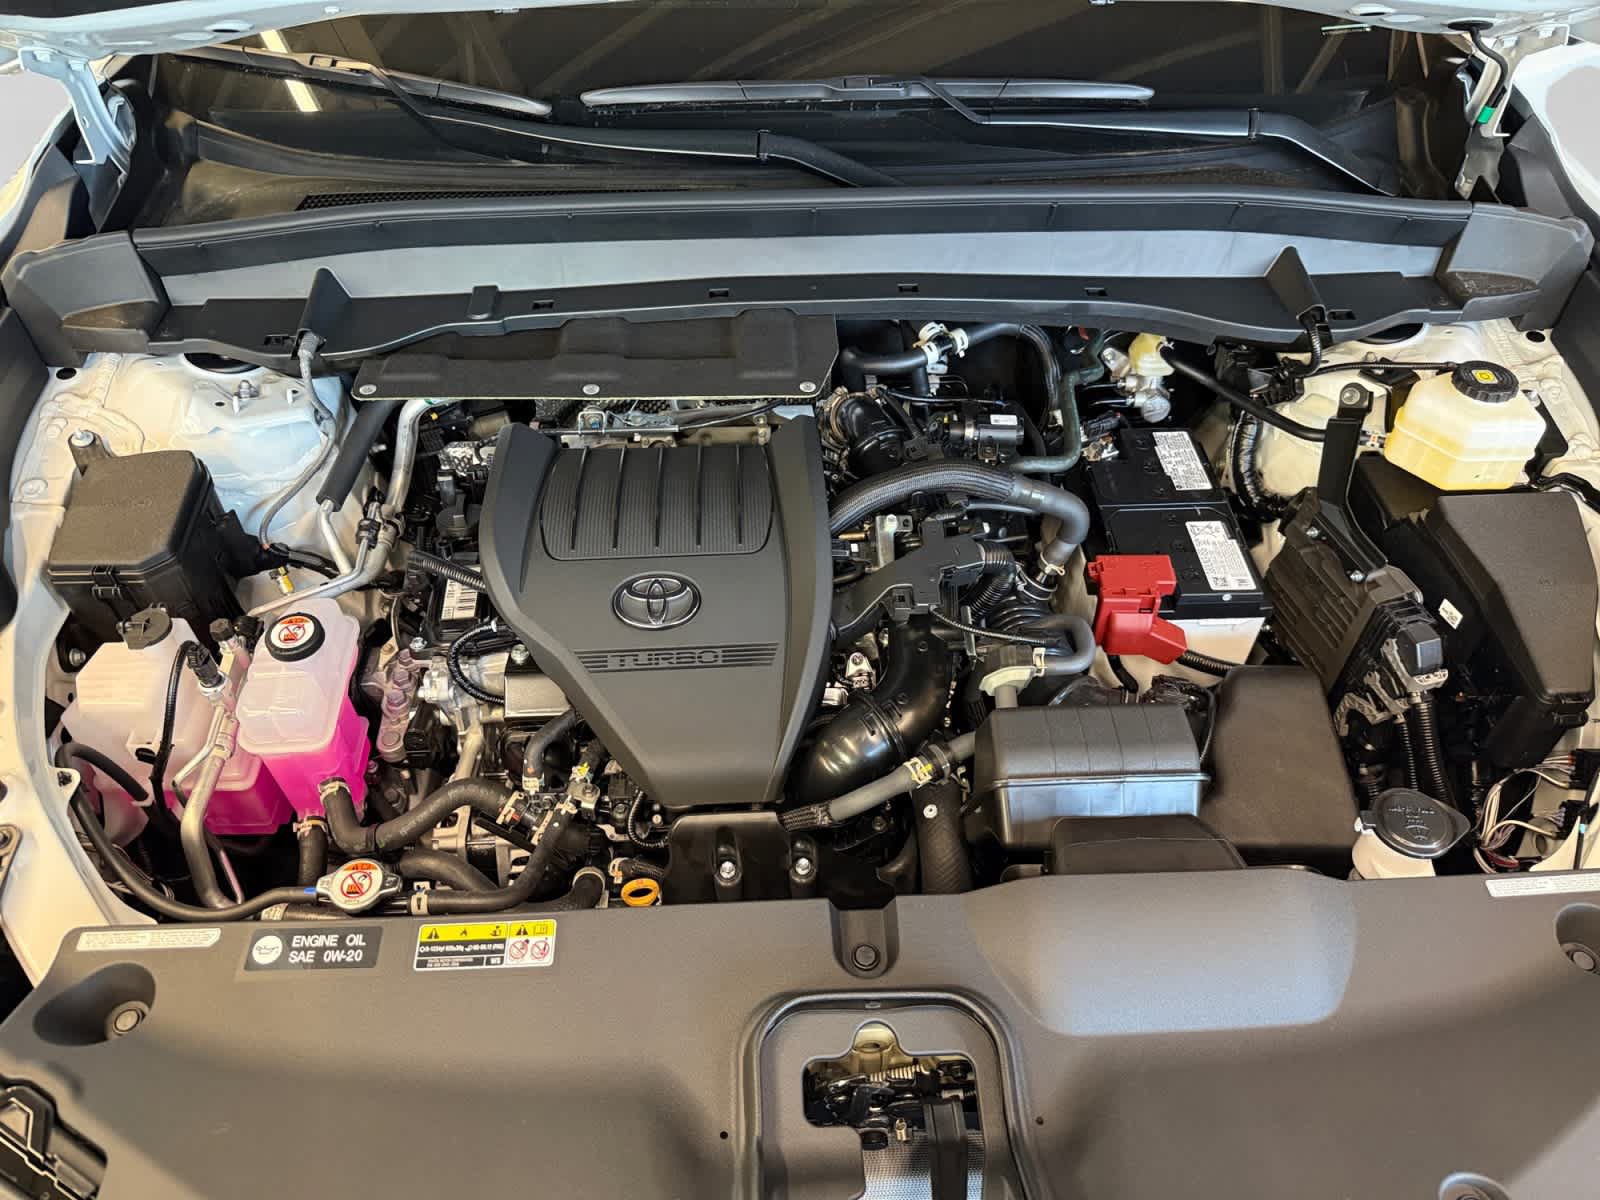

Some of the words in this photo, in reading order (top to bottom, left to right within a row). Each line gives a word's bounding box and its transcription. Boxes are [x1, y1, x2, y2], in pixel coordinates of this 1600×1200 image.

[609, 649, 720, 668] TURBO
[291, 935, 339, 948] ENGINE
[345, 934, 366, 946] OIL
[288, 950, 316, 963] SAE
[323, 949, 363, 963] 0W-20
